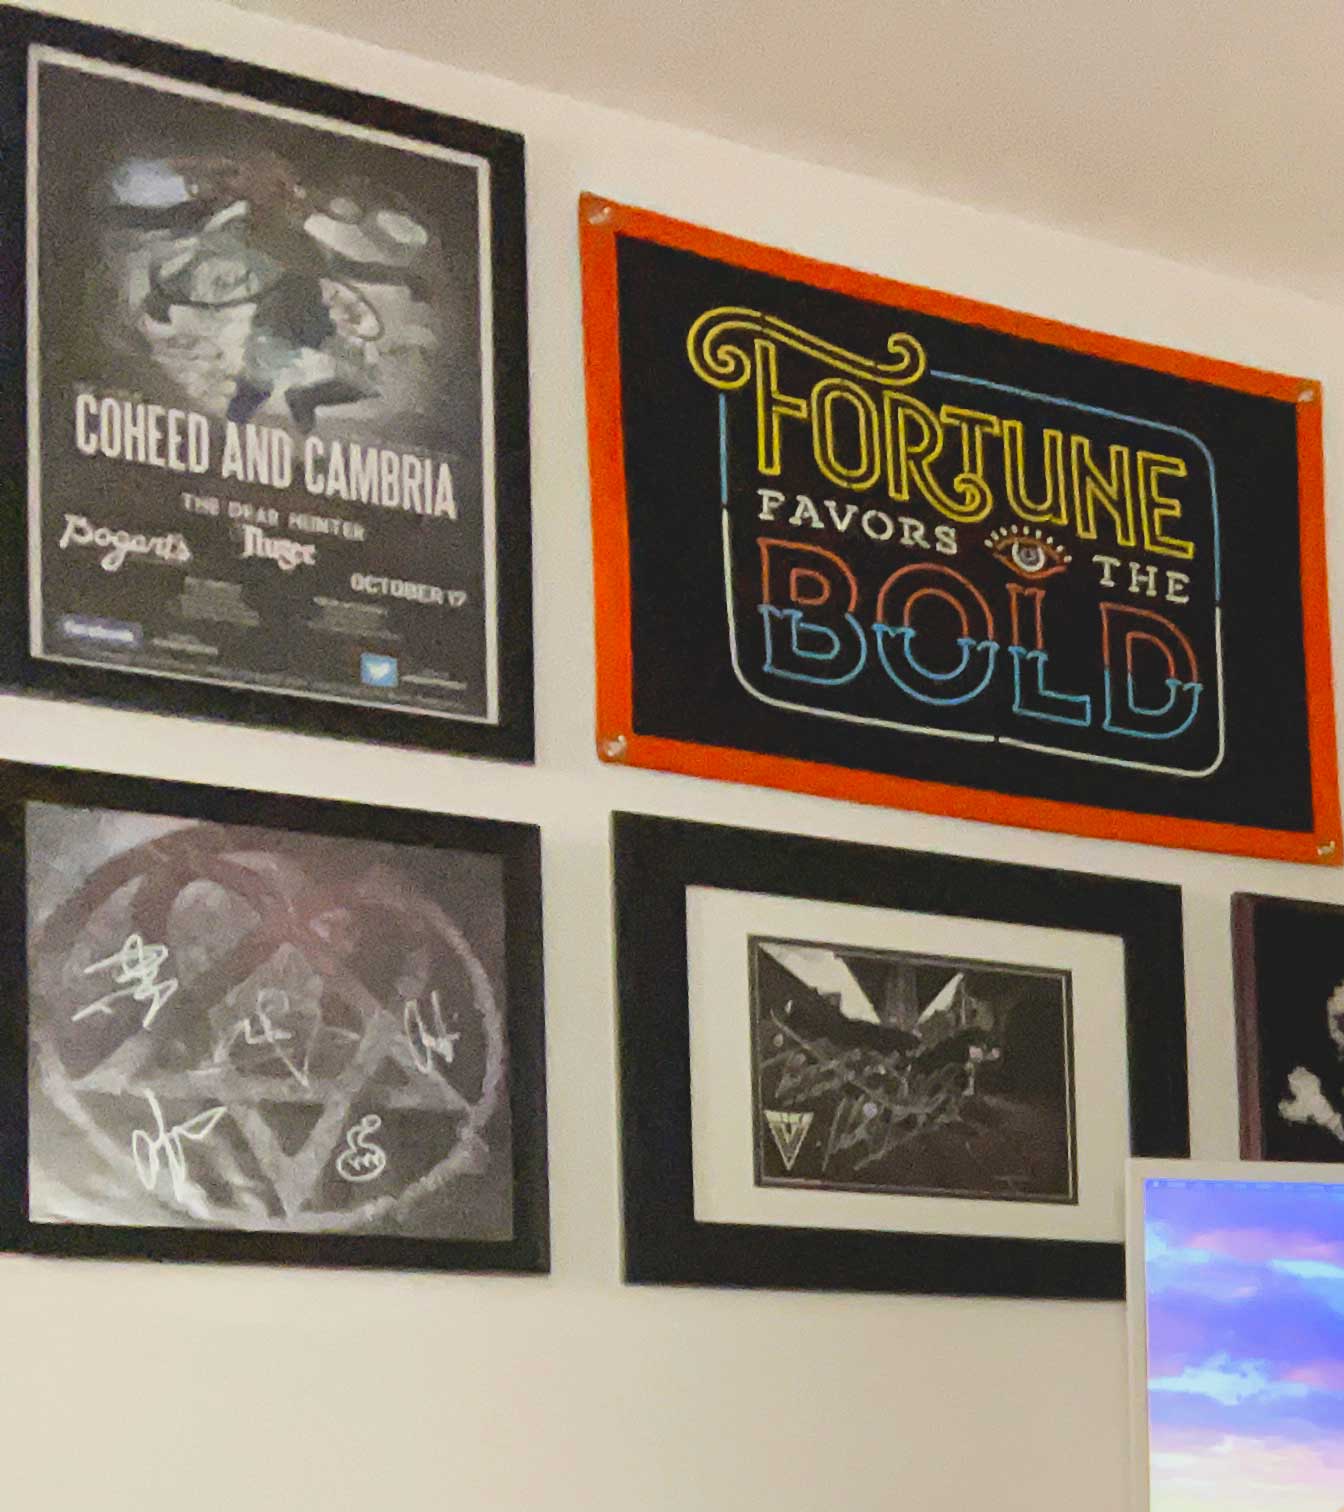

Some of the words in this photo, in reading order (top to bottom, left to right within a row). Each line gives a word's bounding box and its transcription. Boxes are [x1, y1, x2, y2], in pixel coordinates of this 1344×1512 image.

[75, 393, 210, 475] COHEED
[221, 420, 294, 490] AND
[304, 434, 458, 521] CAMBRIA
[686, 305, 1194, 559] FORTUNE
[350, 572, 444, 605] OCTOBER
[756, 488, 960, 556] FAVORS
[1092, 553, 1193, 605] THE
[757, 537, 1206, 741] BOLD
